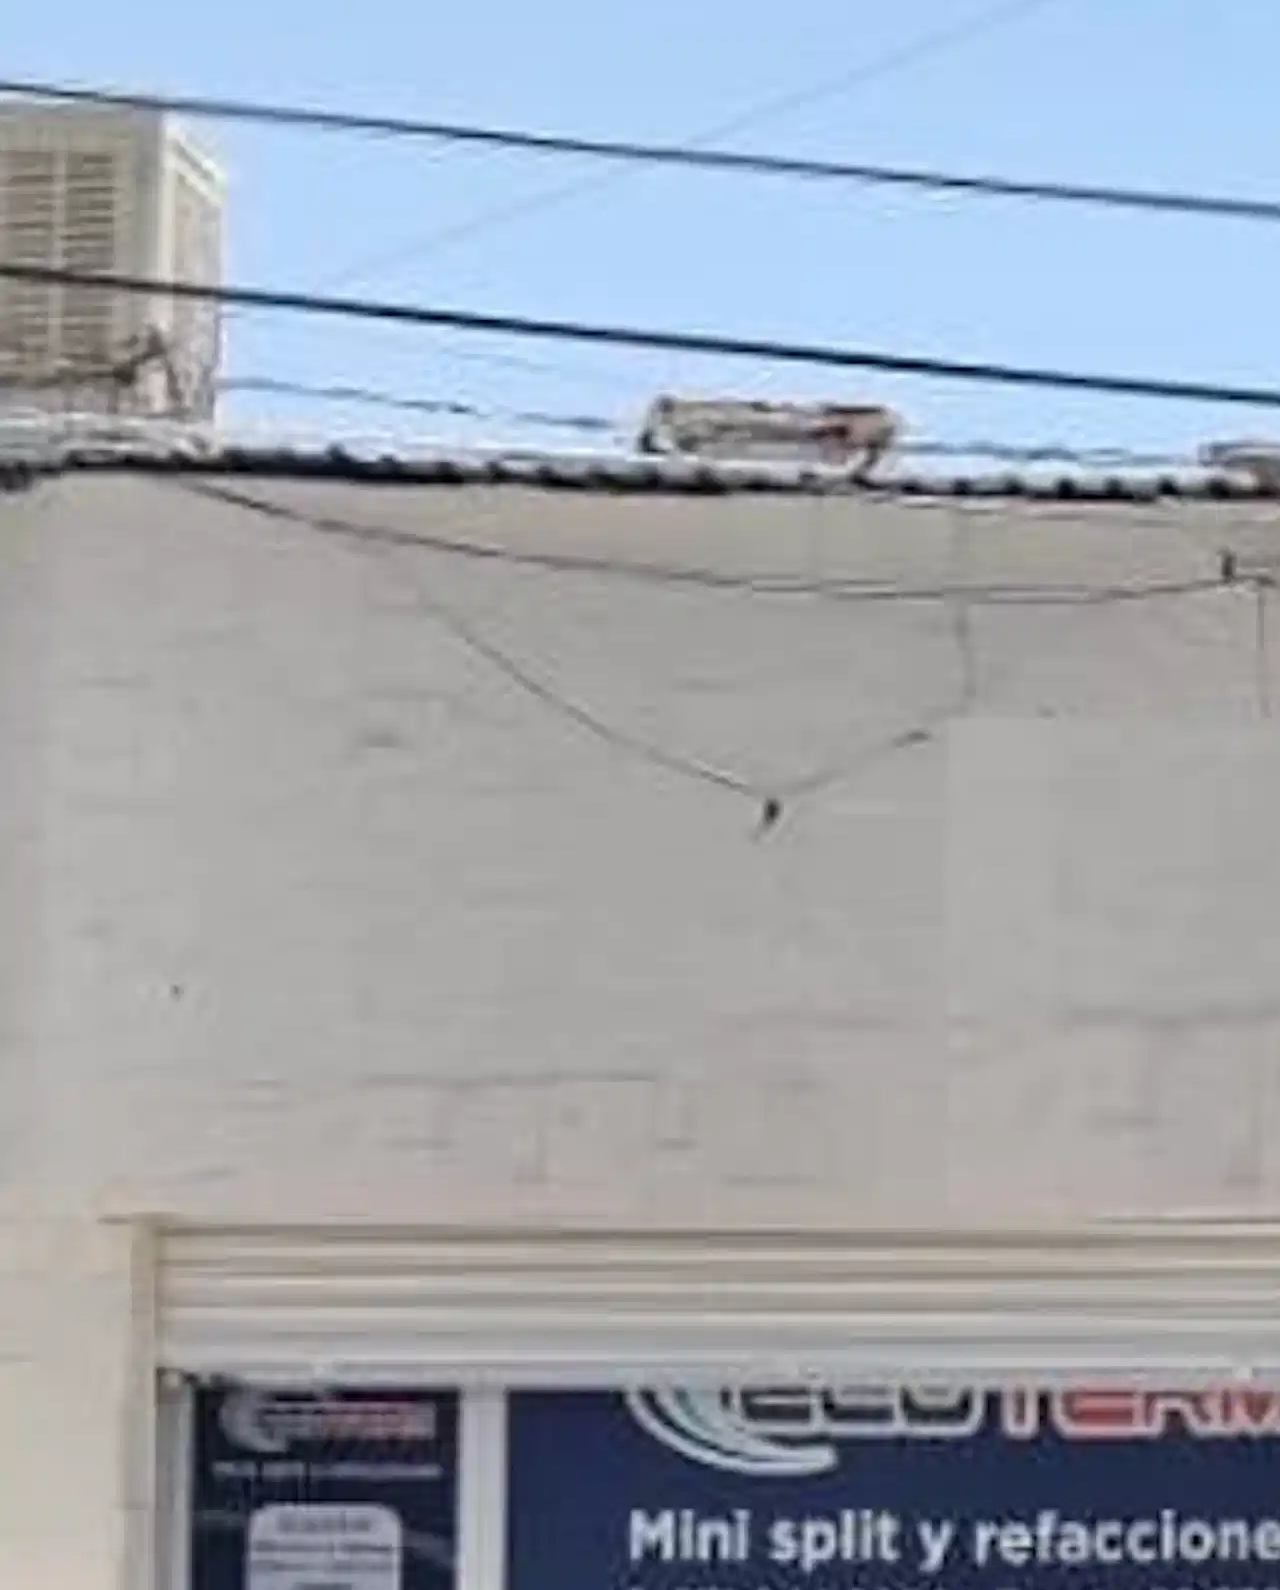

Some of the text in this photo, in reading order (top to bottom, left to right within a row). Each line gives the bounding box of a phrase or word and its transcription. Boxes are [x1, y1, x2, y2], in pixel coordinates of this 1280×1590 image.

[629, 1509, 750, 1561] Mini
[769, 1509, 901, 1574] split
[916, 1520, 956, 1574] y
